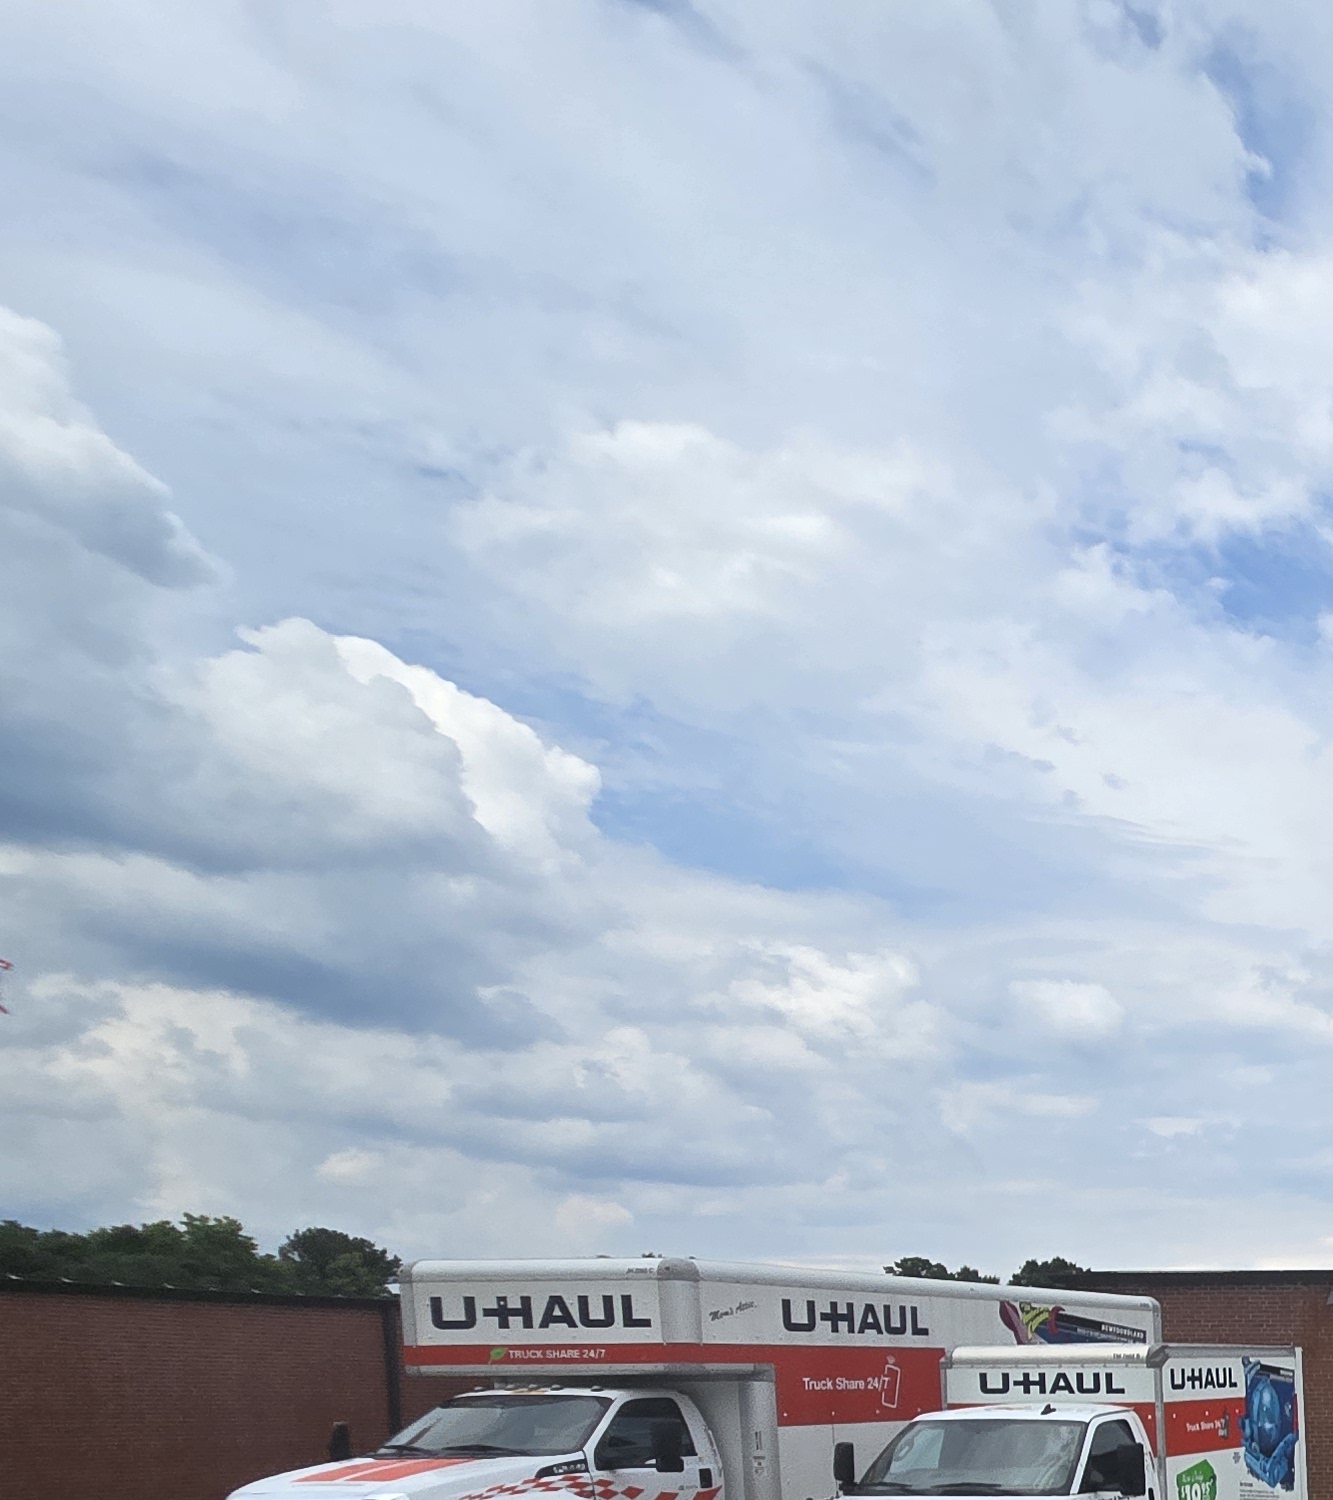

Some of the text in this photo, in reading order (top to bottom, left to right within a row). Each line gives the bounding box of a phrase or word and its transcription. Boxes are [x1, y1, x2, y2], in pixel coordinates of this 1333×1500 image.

[430, 1294, 652, 1330] U-HAUL
[781, 1298, 929, 1336] U-HAUL
[508, 1348, 606, 1360] TRUCK SHARE 24/7
[802, 1375, 891, 1392] Truck Share 24/7
[979, 1371, 1126, 1395] U-HAUL
[1170, 1367, 1238, 1390] U-HAUL
